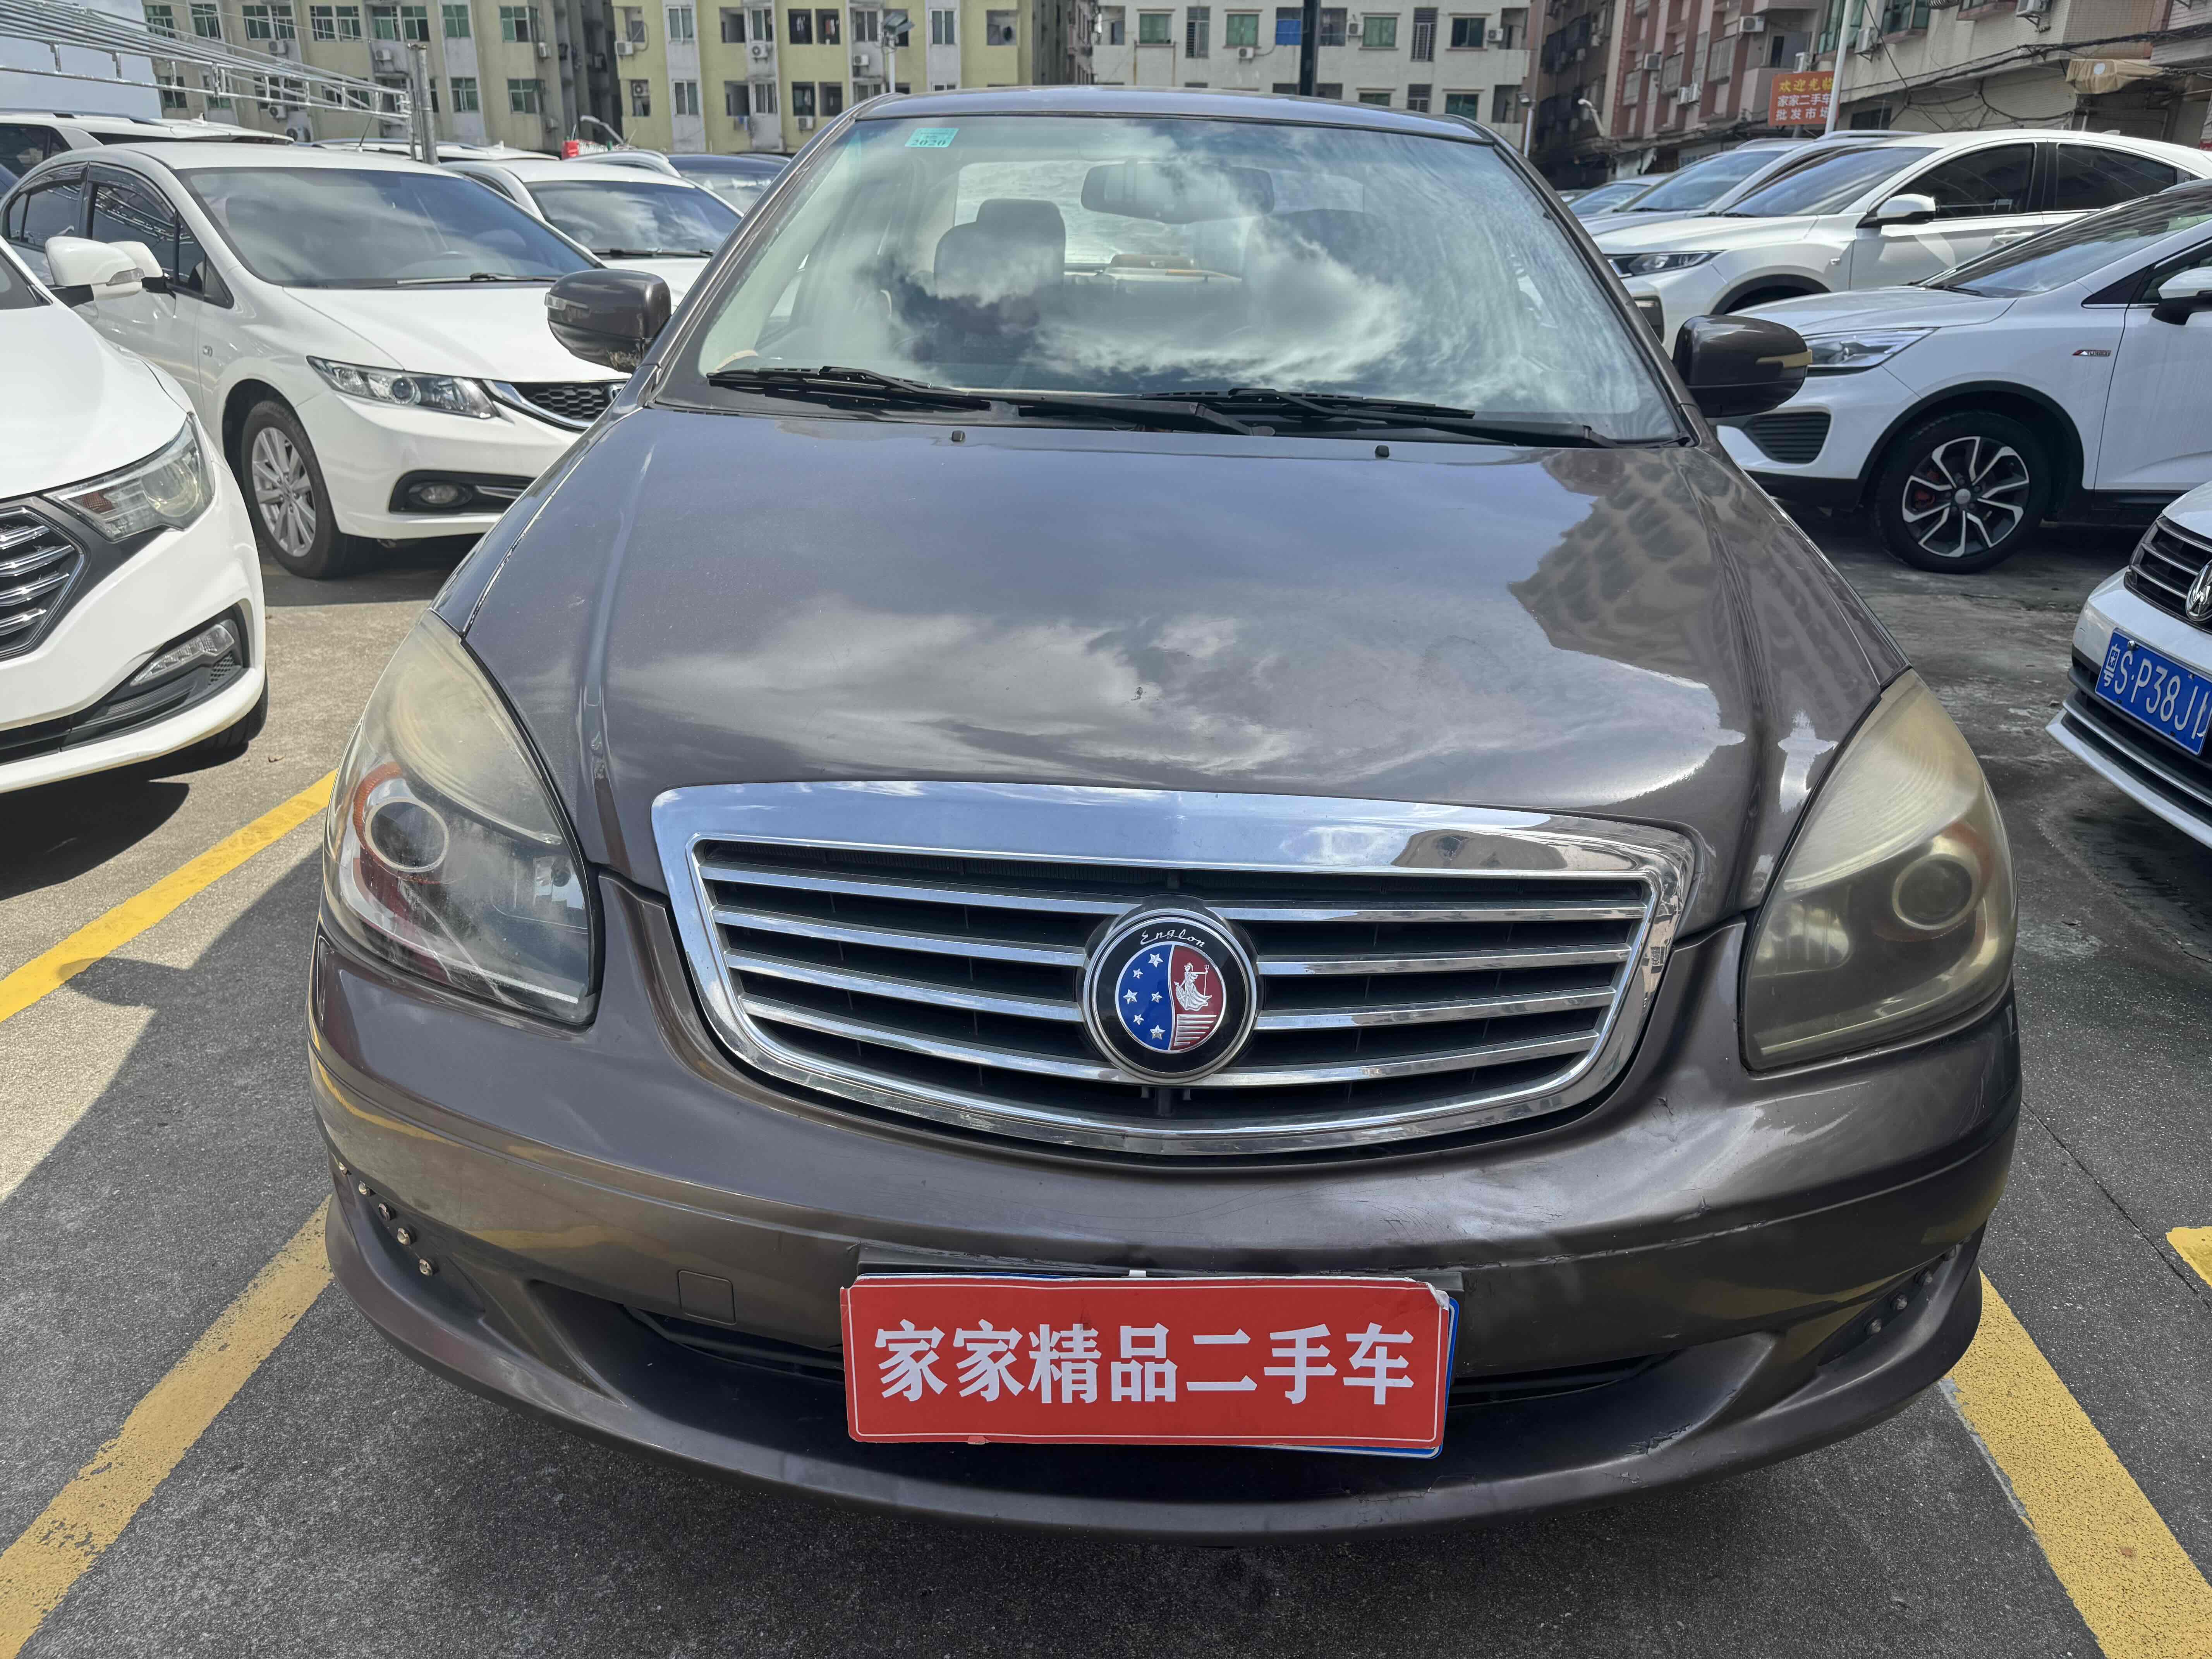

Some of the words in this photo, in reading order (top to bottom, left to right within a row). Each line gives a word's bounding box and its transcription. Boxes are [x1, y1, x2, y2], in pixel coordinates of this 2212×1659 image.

[1778, 77, 1833, 92] 欢迎光临
[1778, 93, 1831, 107] 家家二手车
[1776, 106, 1829, 120] 批发市场
[1140, 929, 1205, 947] Englon
[874, 1319, 1414, 1405] 家家精品二手车
